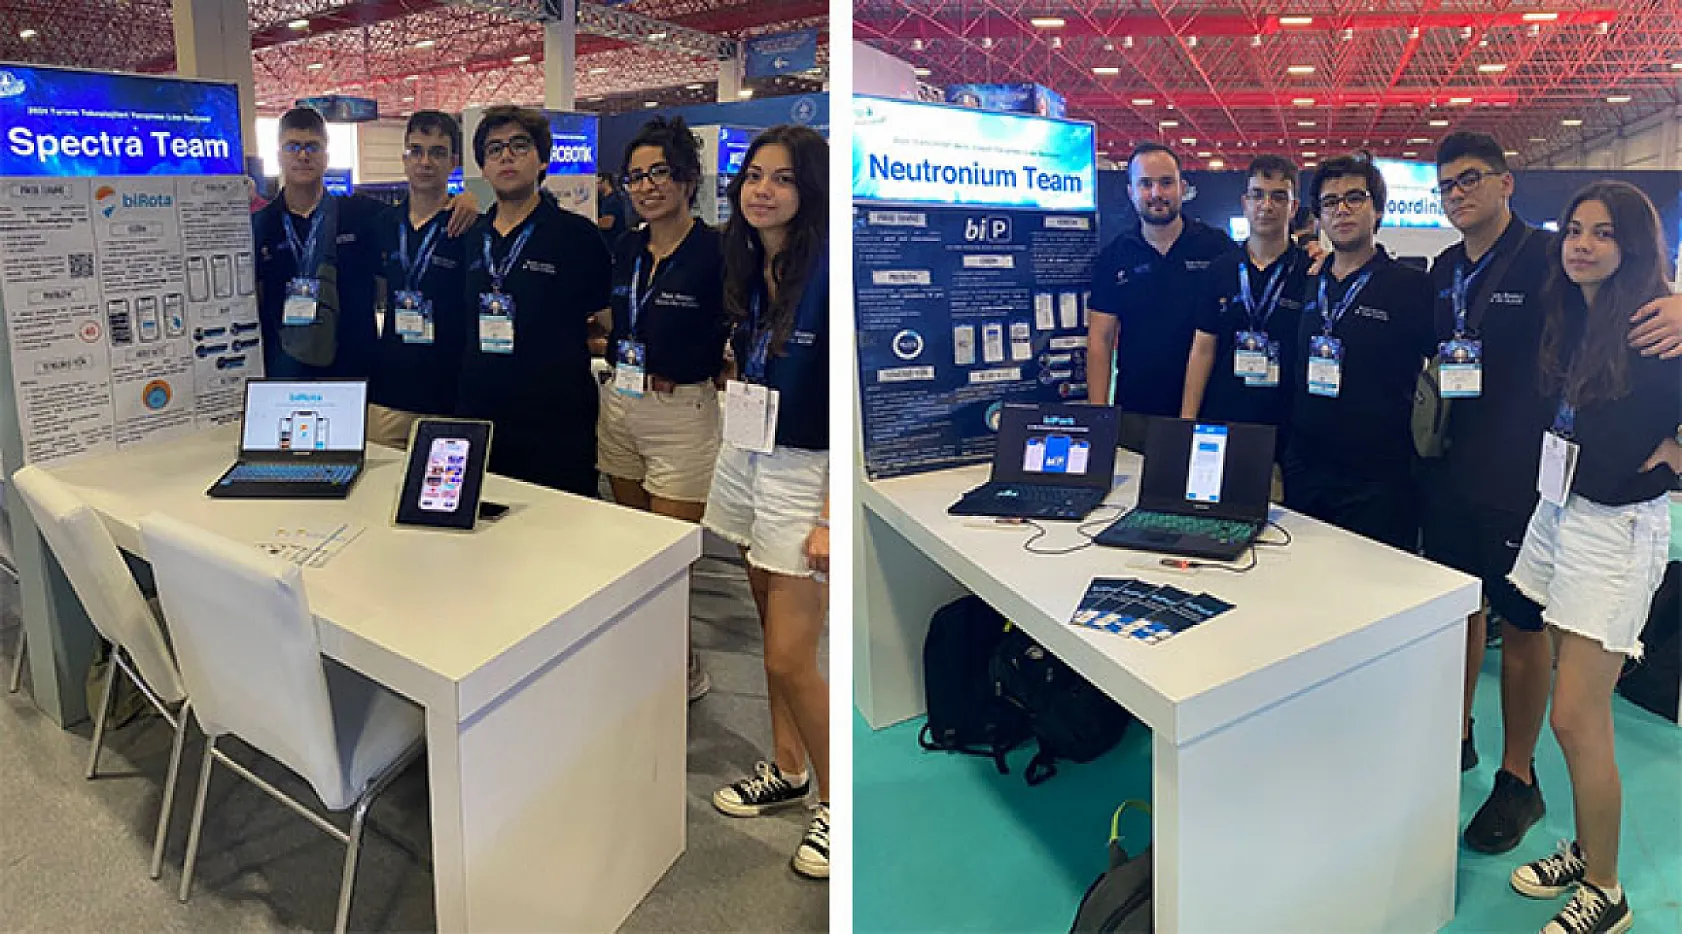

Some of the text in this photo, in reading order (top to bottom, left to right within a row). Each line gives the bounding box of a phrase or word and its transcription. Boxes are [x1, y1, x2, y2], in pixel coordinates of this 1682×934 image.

[7, 127, 229, 162] Spectra Team
[869, 153, 1082, 192] Neutronium Team
